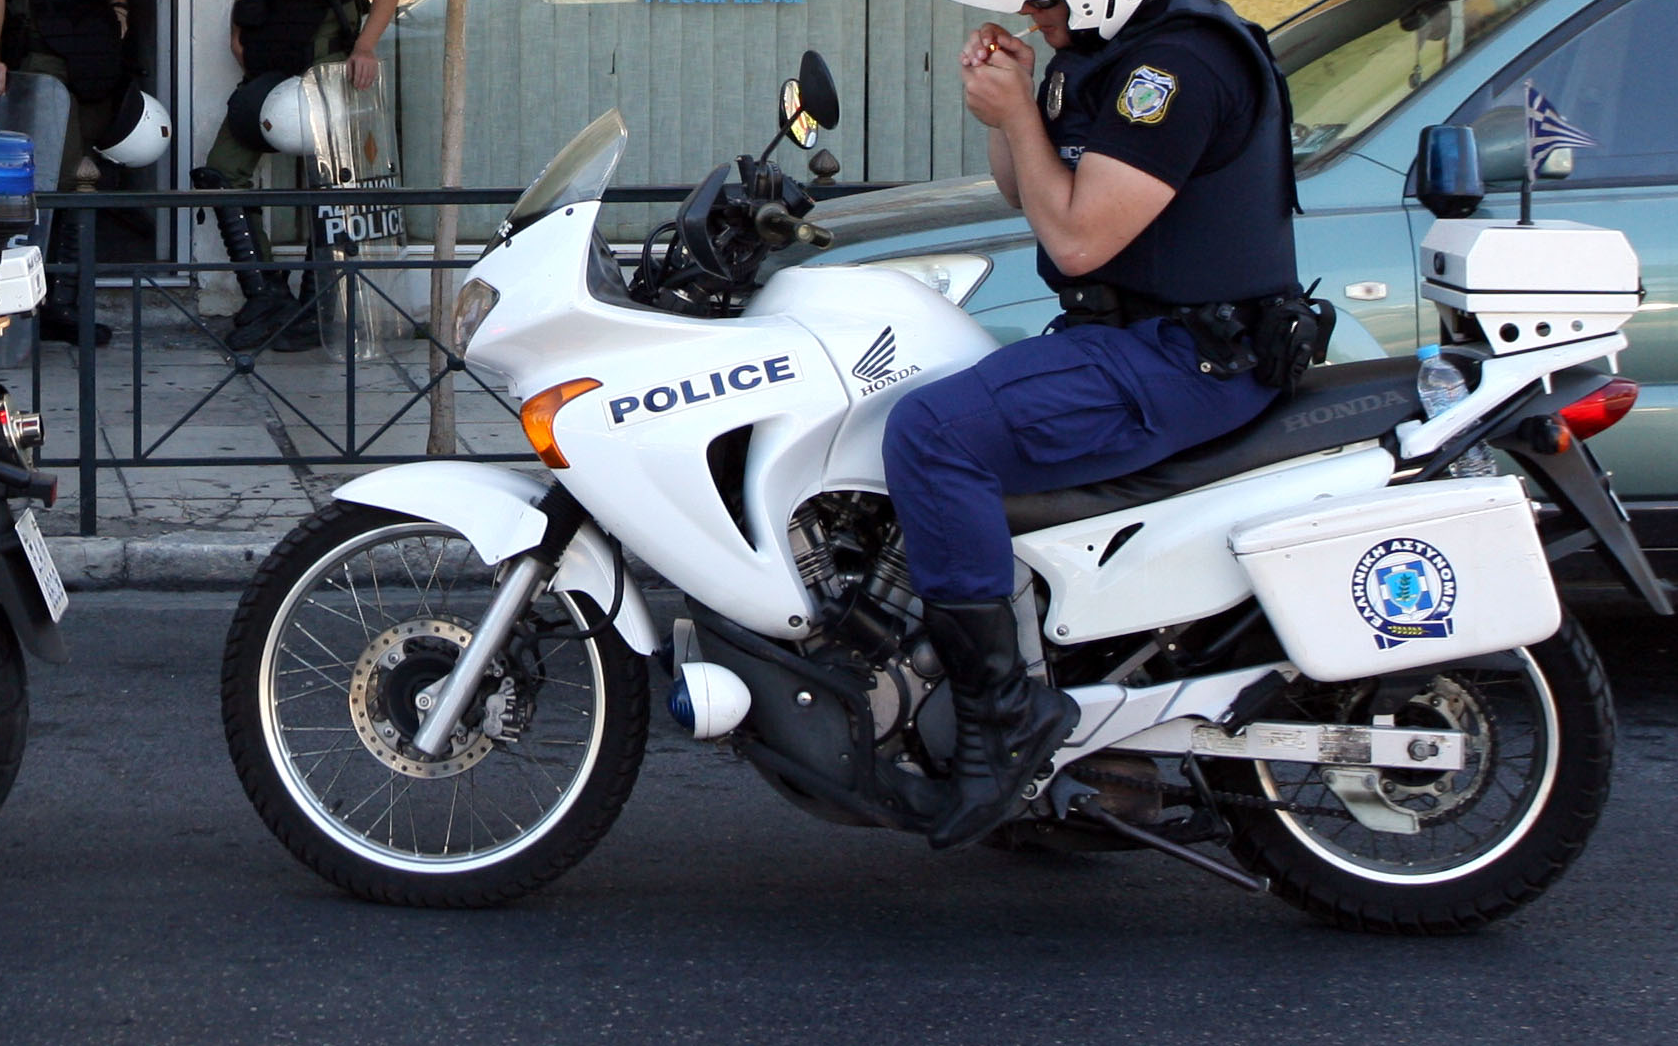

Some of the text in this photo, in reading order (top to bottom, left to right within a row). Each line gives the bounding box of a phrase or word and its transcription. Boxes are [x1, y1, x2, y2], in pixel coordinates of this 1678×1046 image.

[608, 355, 795, 424] POLICE
[859, 363, 922, 398] HONDA
[1282, 390, 1410, 433] HONDA
[1353, 540, 1455, 628] ΕΛΛΗΝΙΚΗ ΑΣΤΥΝΟΜΙΑ
